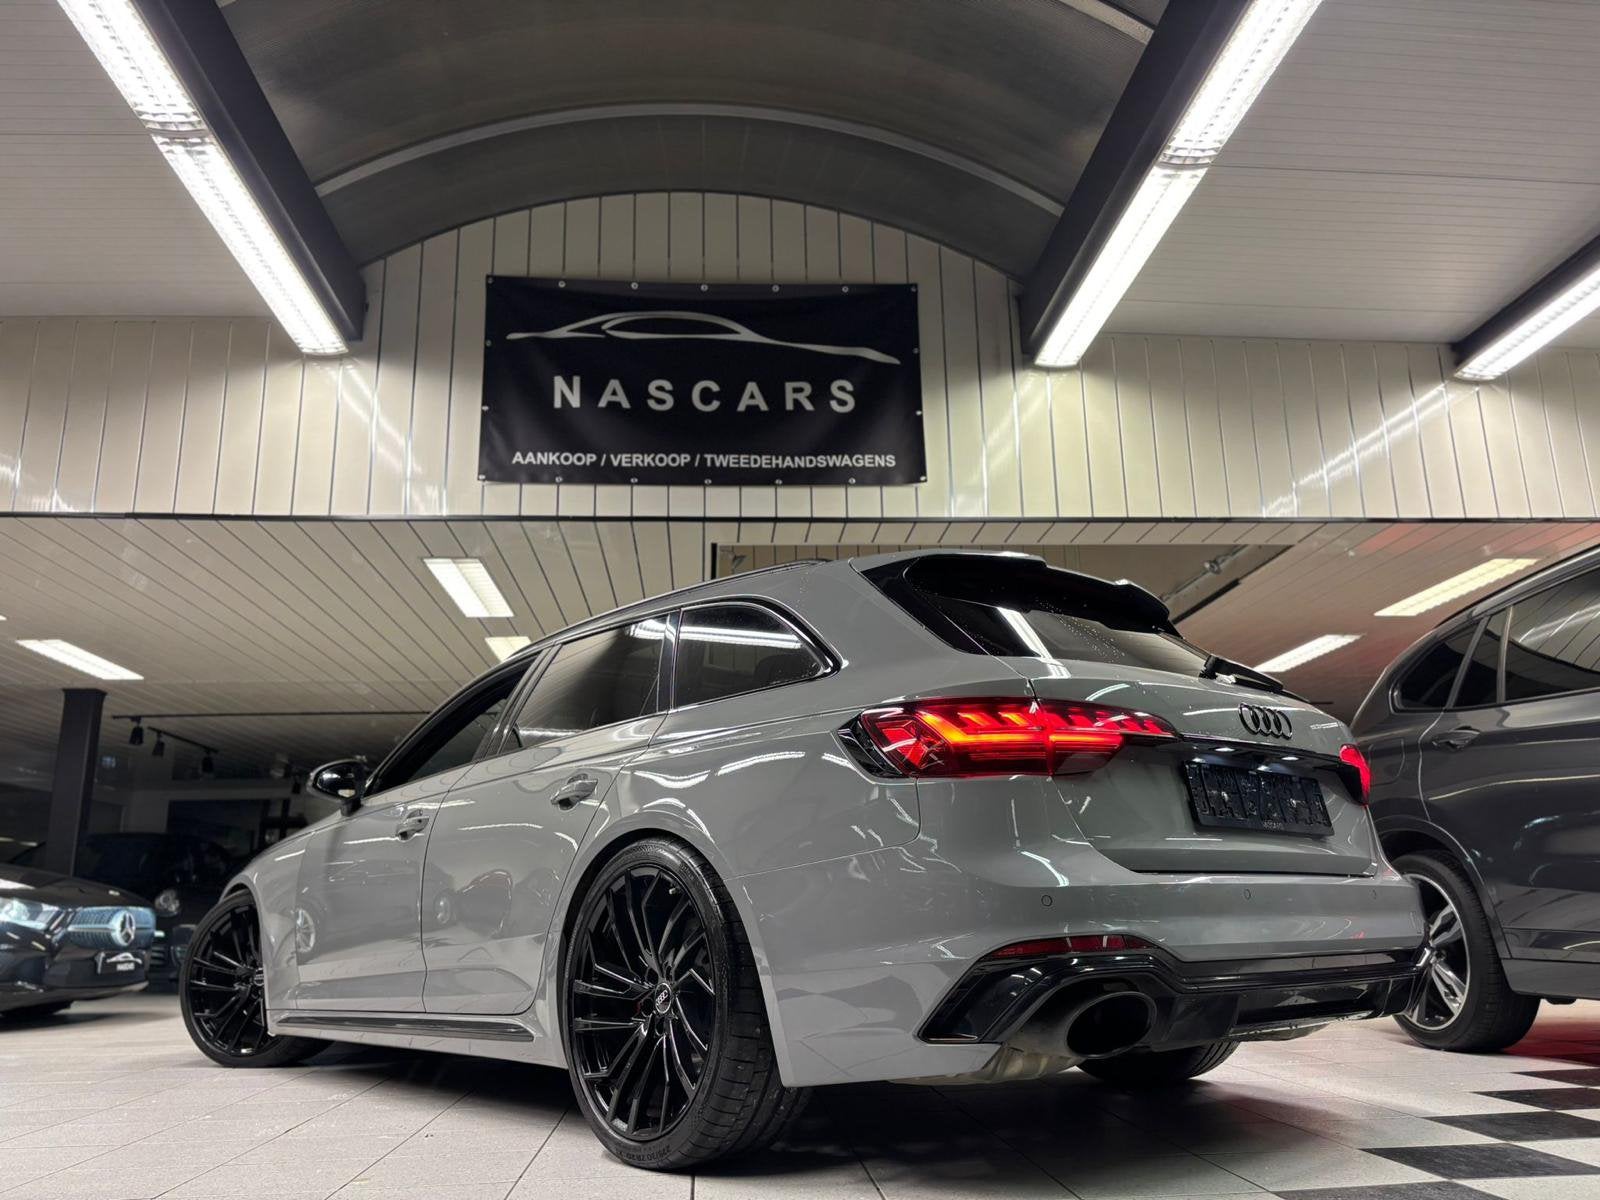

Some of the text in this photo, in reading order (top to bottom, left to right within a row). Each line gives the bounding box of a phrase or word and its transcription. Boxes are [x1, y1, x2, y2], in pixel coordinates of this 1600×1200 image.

[553, 375, 855, 413] NASCARS
[511, 451, 597, 466] AANKOOP
[610, 453, 691, 467] VERKOOP
[704, 453, 896, 468] TWEEDEHANDSWAGENS
